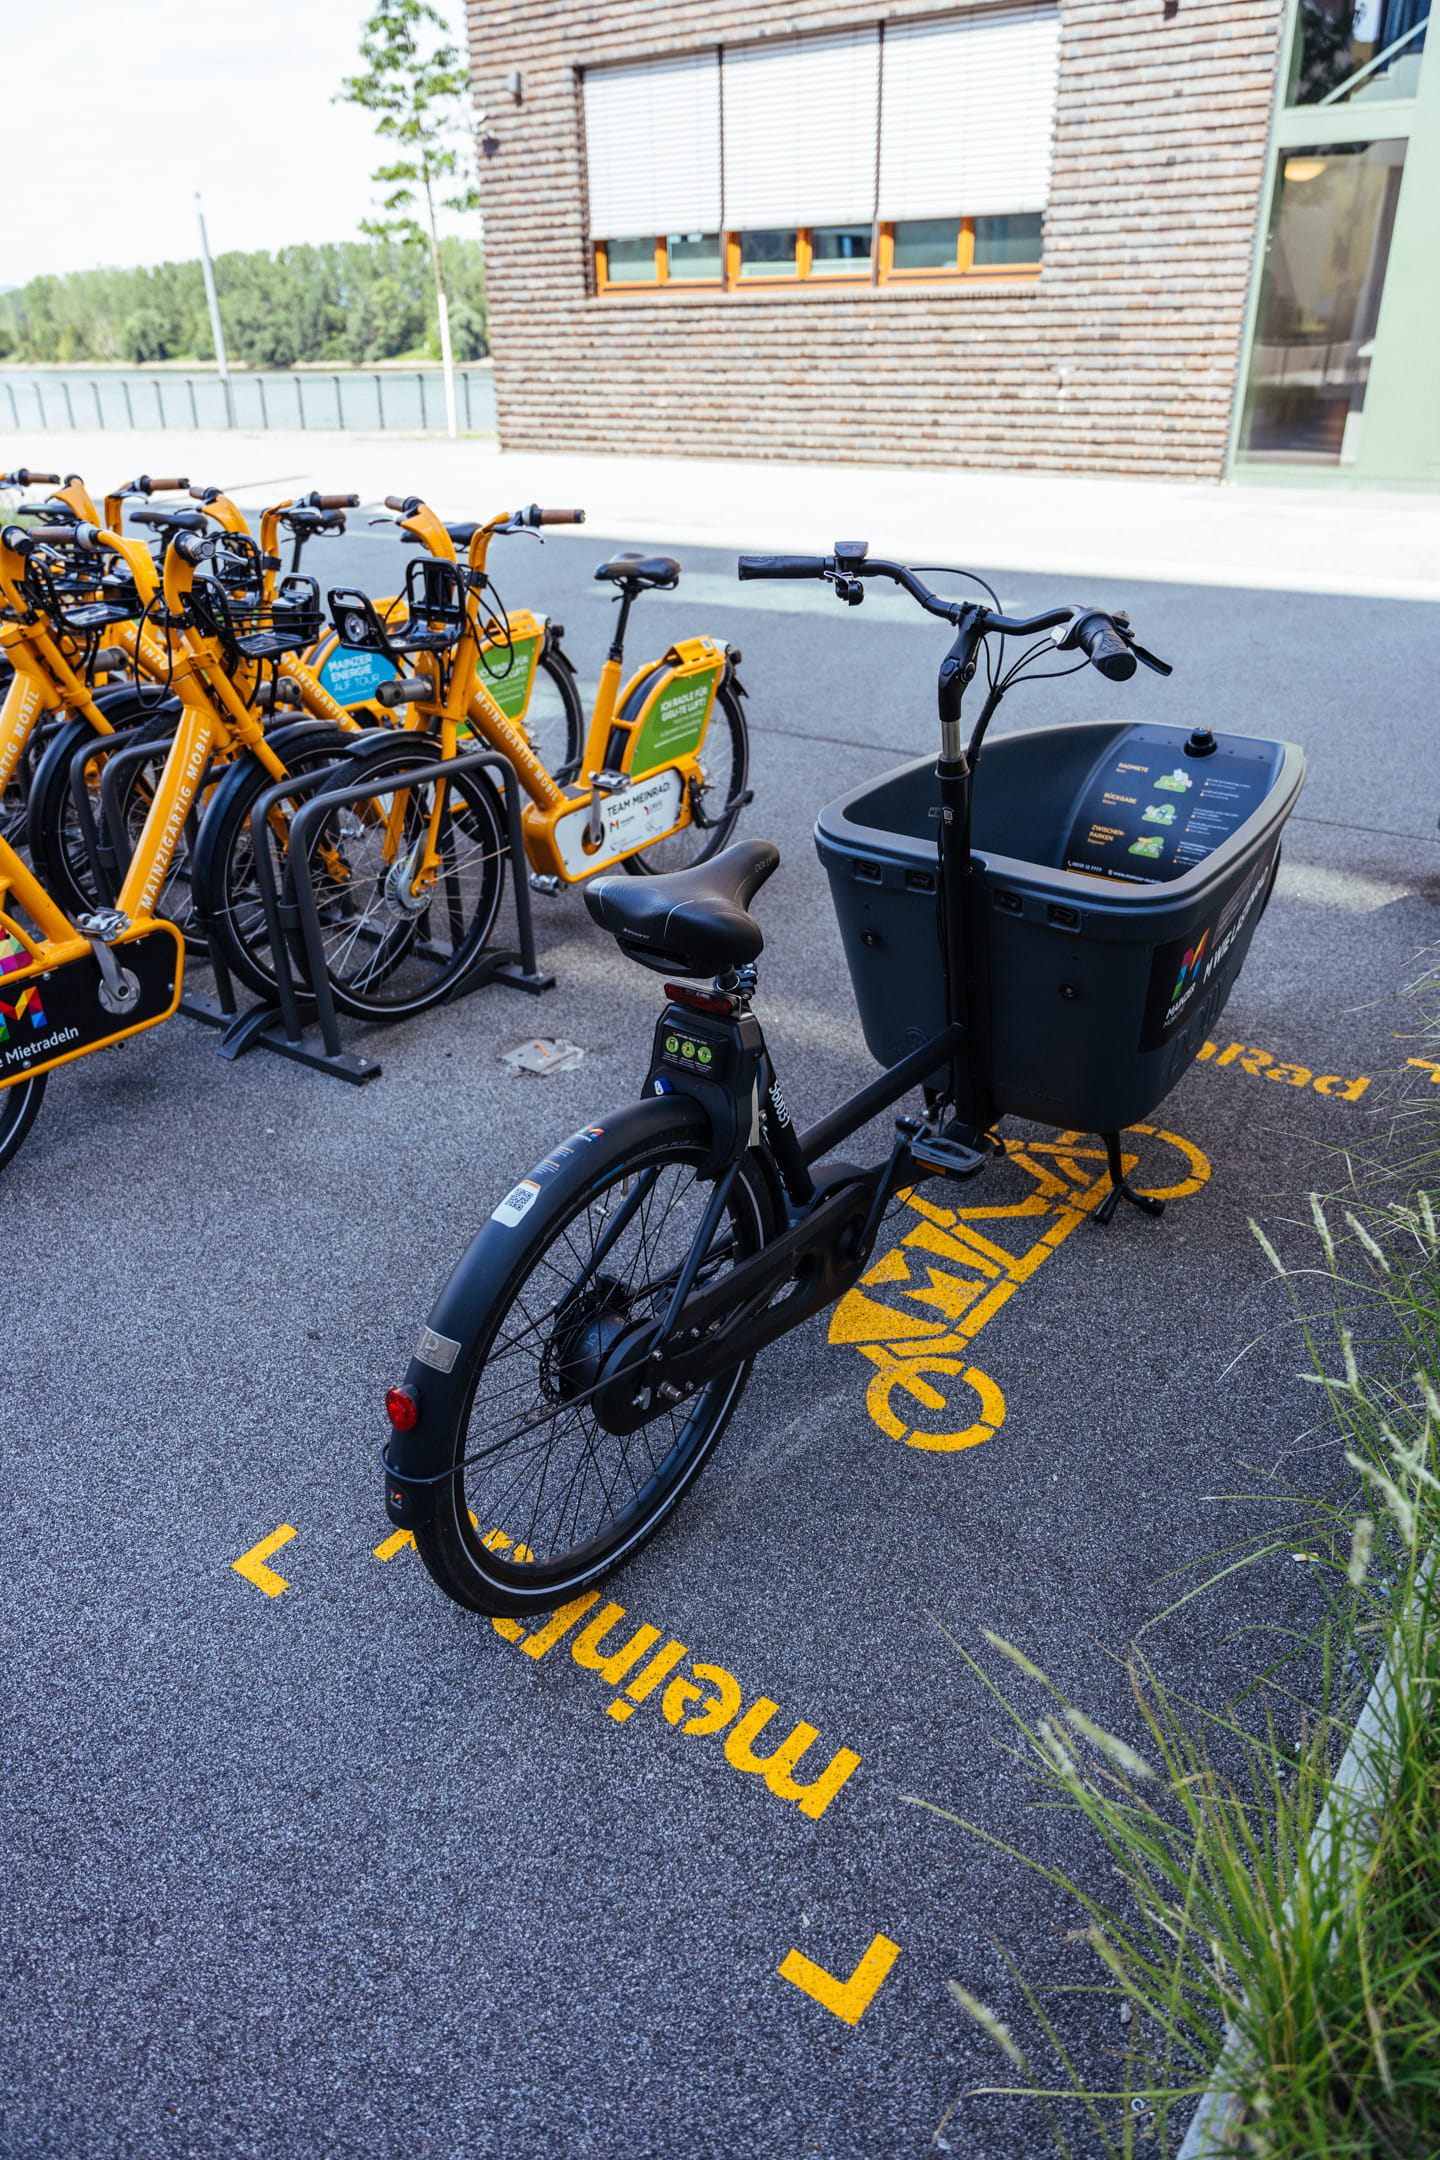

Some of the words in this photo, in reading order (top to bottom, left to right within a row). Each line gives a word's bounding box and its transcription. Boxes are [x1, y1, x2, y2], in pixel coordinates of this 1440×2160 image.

[13, 691, 40, 738] MOBIL
[474, 691, 535, 769] MAINZIGARTIG
[534, 767, 560, 801] MOBIL
[139, 785, 192, 910] MAINZIGARTIG
[186, 728, 211, 781] MOBIL
[607, 800, 631, 816] TEAM
[5, 1027, 79, 1064] Mietradeln
